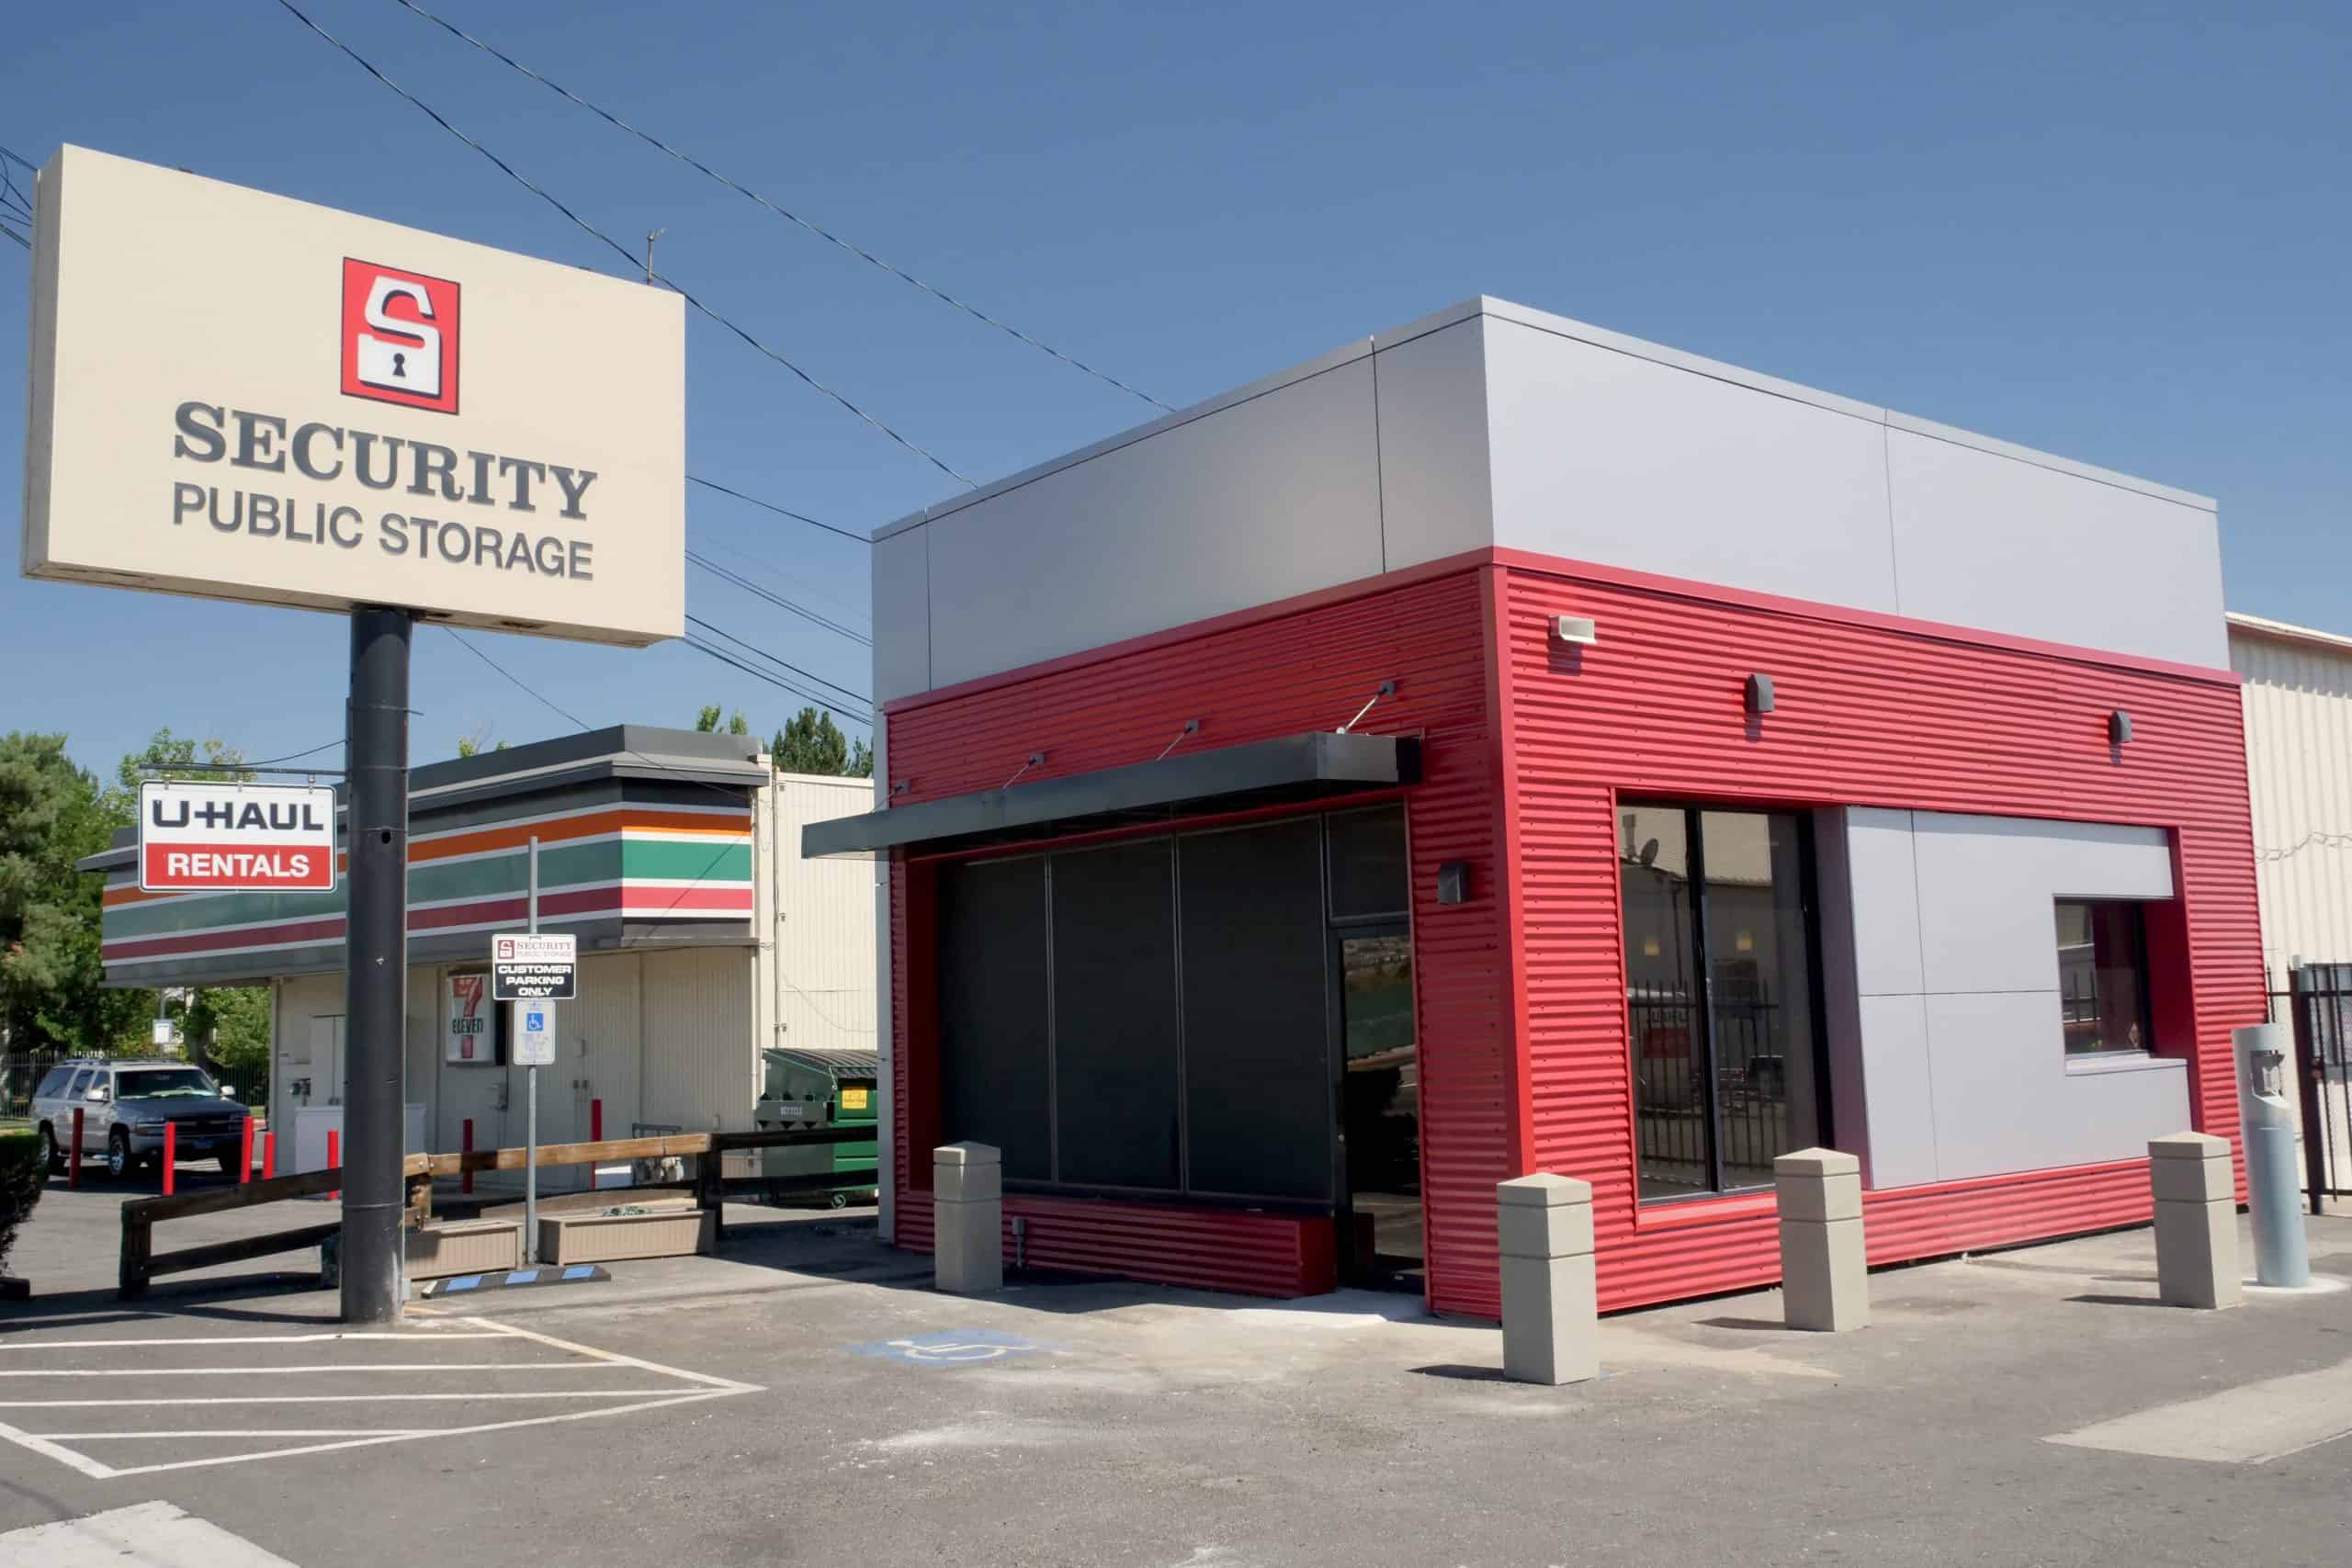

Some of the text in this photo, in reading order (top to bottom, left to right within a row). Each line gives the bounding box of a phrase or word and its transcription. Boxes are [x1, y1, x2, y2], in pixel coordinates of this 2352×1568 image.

[174, 400, 598, 521] SECURITY
[173, 480, 594, 581] PUBLIC STORAGE
[152, 799, 324, 831] U-HAUL
[167, 852, 310, 877] RENTALS
[516, 941, 573, 950] SECURITY
[498, 965, 571, 974] CUSTOMER
[506, 976, 564, 985] PARKING
[518, 987, 552, 996] ONLY
